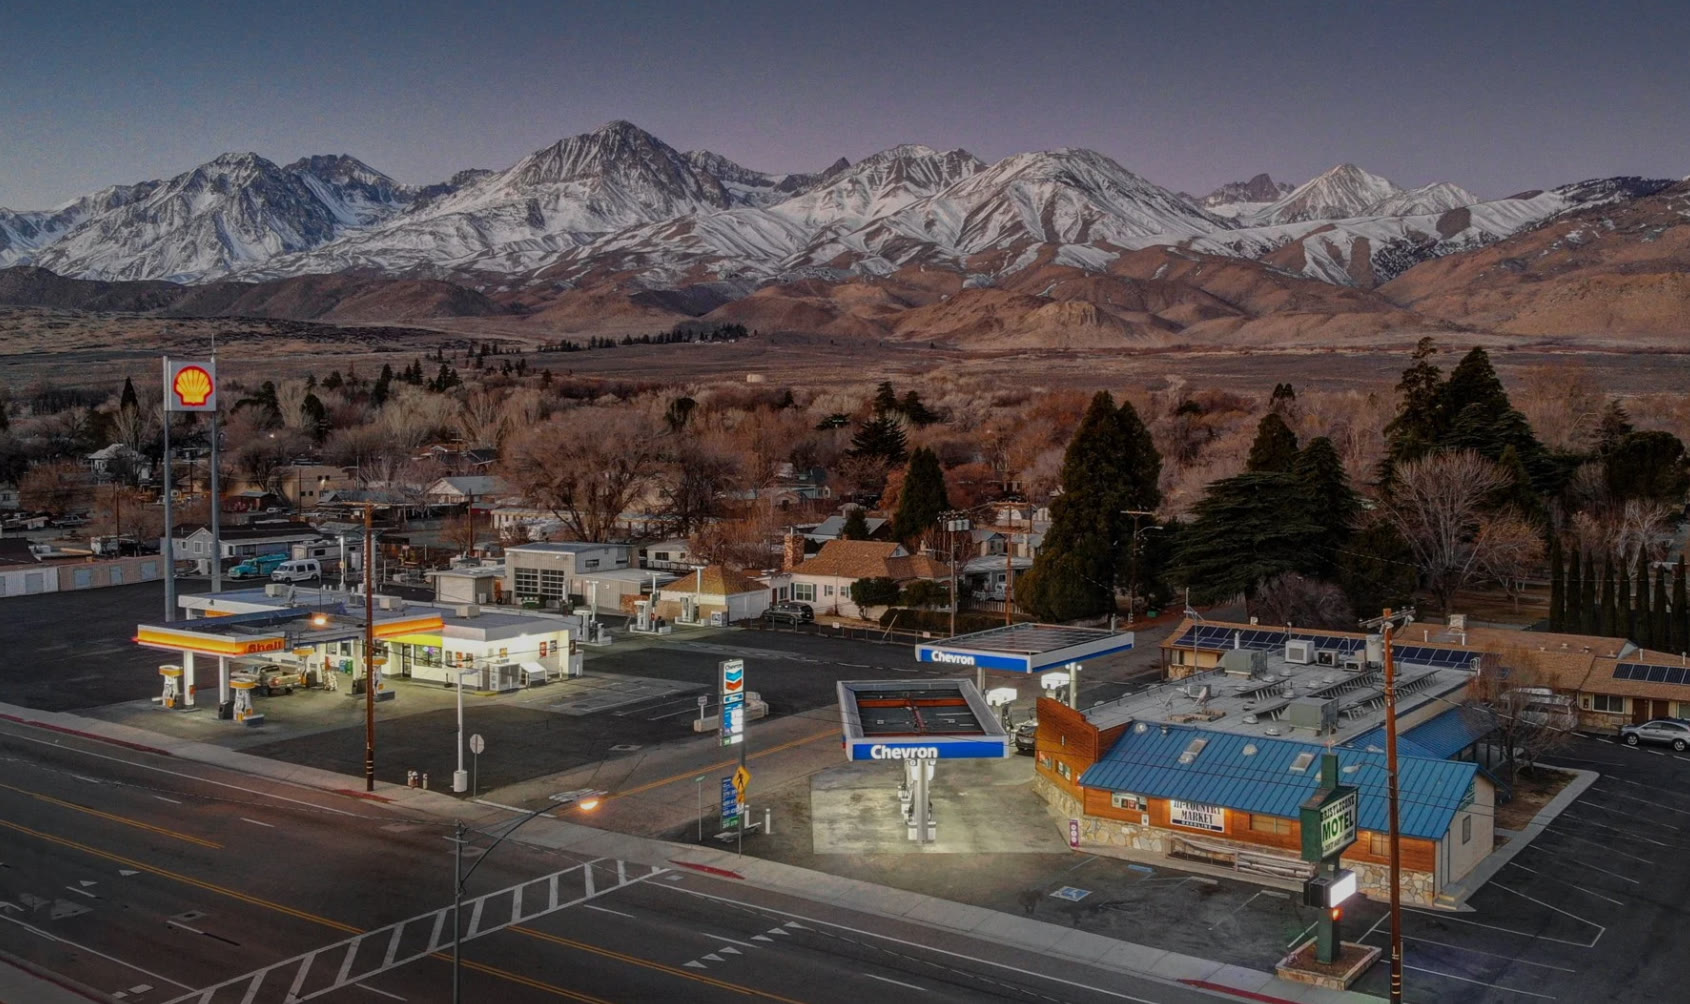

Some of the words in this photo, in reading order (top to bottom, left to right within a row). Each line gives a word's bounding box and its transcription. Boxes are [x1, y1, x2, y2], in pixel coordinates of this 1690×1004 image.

[248, 641, 282, 653] Shell
[931, 650, 975, 665] Chevron
[870, 745, 938, 759] Chevron
[1181, 810, 1213, 824] MARKET
[1323, 810, 1353, 841] MOTEL
